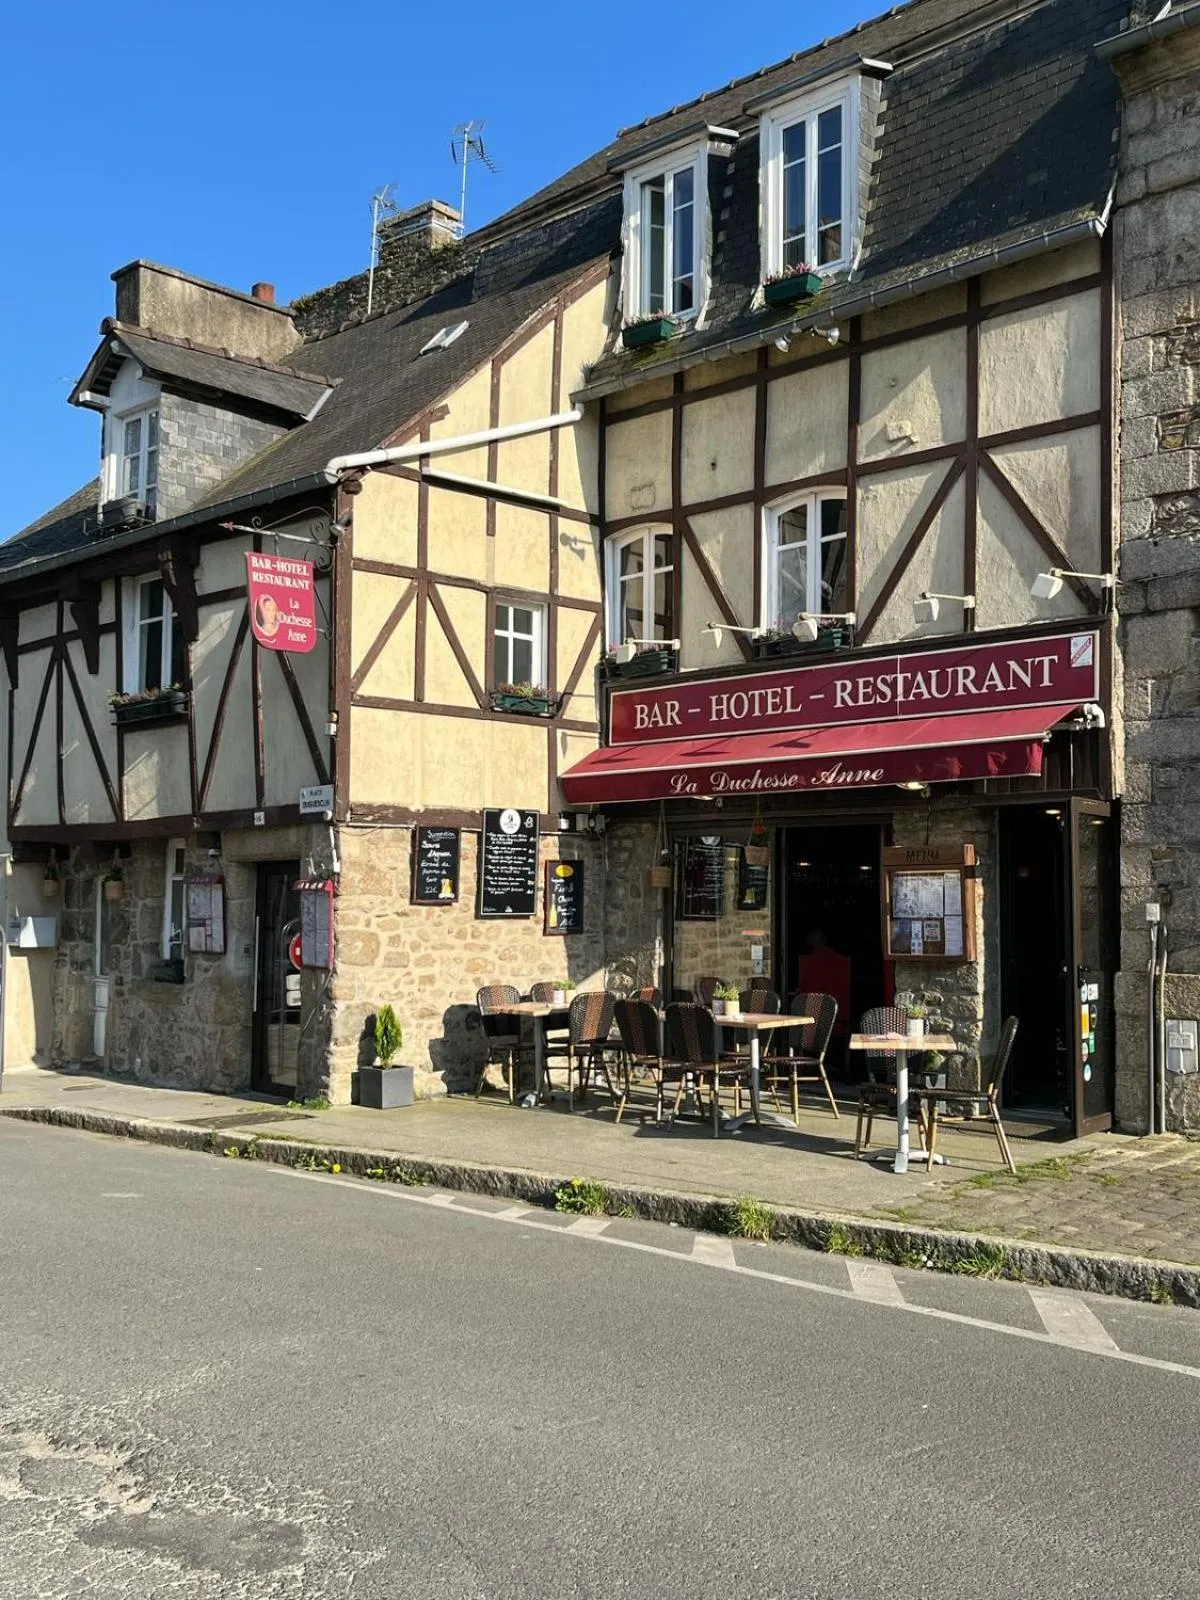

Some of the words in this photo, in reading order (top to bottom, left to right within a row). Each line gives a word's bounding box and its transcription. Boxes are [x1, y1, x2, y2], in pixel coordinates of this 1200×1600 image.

[251, 556, 310, 577] BAR-HOTEL
[251, 571, 310, 591] RESTAURANT
[289, 597, 300, 609] La
[278, 611, 313, 628] Duchesse
[287, 628, 307, 643] Anne
[633, 700, 683, 730] BAR
[708, 685, 803, 722] HOTEL
[833, 655, 1059, 709] RESTAURANT
[669, 773, 699, 794] La
[709, 768, 799, 792] Duchesse
[810, 761, 885, 785] Anne
